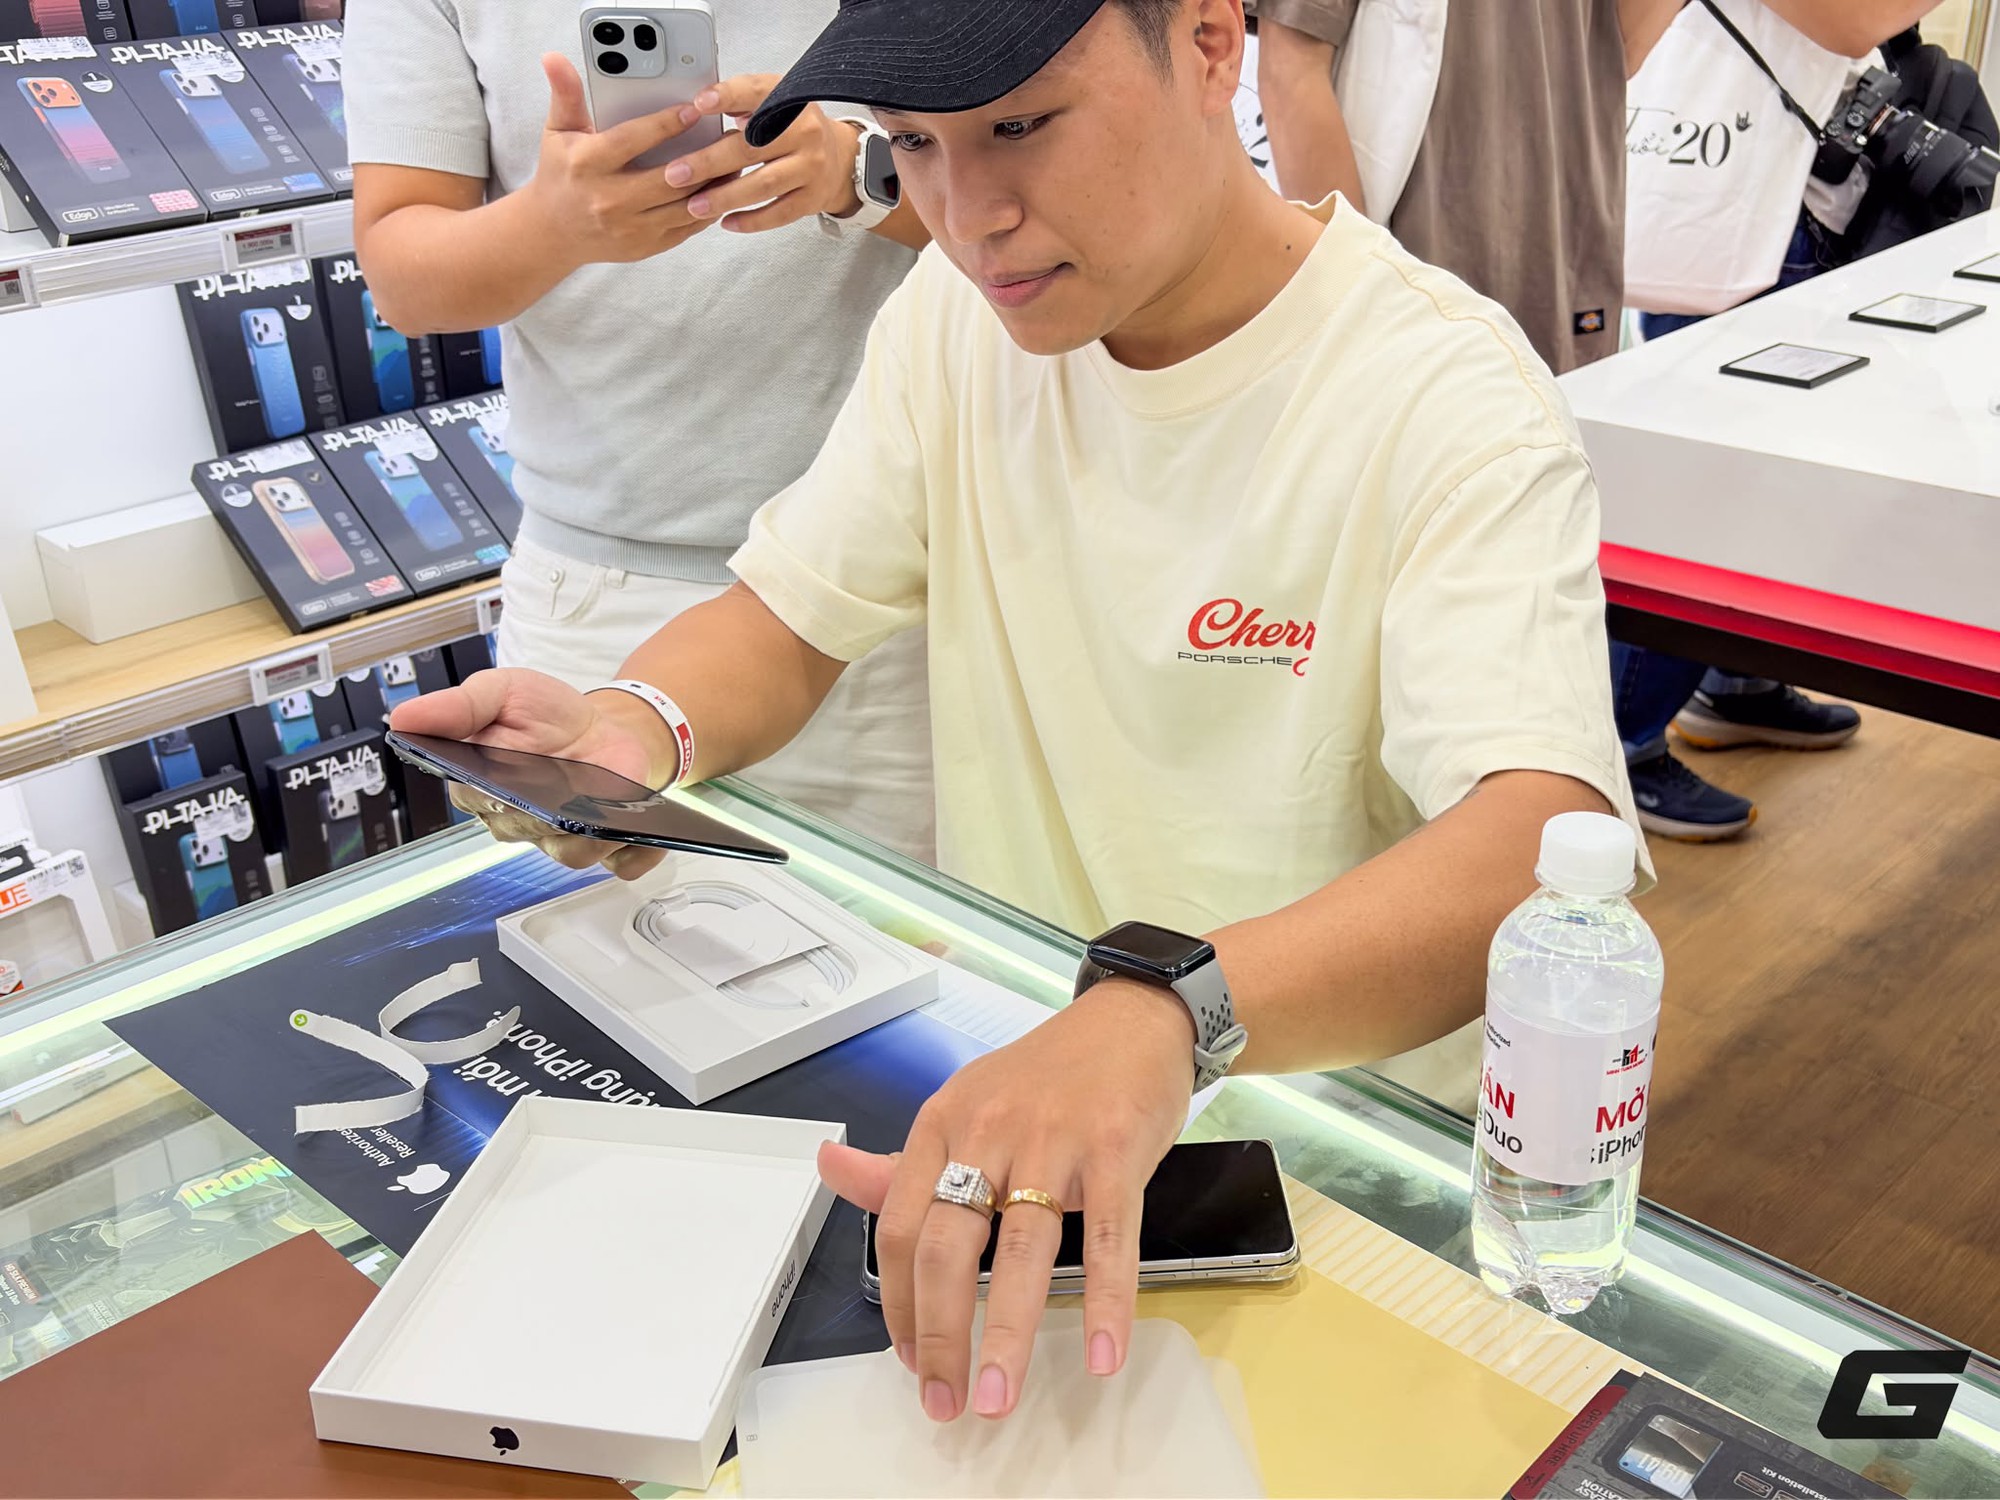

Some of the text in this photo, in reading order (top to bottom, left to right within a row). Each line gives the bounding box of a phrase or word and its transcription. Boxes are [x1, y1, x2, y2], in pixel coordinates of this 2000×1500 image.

[1668, 120, 1732, 169] 20
[1177, 651, 1293, 667] PORSCHE
[1595, 1083, 1647, 1134] MỞ
[339, 1127, 396, 1167] Authorize
[370, 1126, 417, 1159] Reseller
[1482, 1107, 1523, 1154] Duo
[771, 1259, 797, 1318] iPhone
[1577, 1408, 1602, 1432] OPEN
[1545, 1443, 1571, 1467] HERE
[1761, 1466, 1778, 1479] Kit
